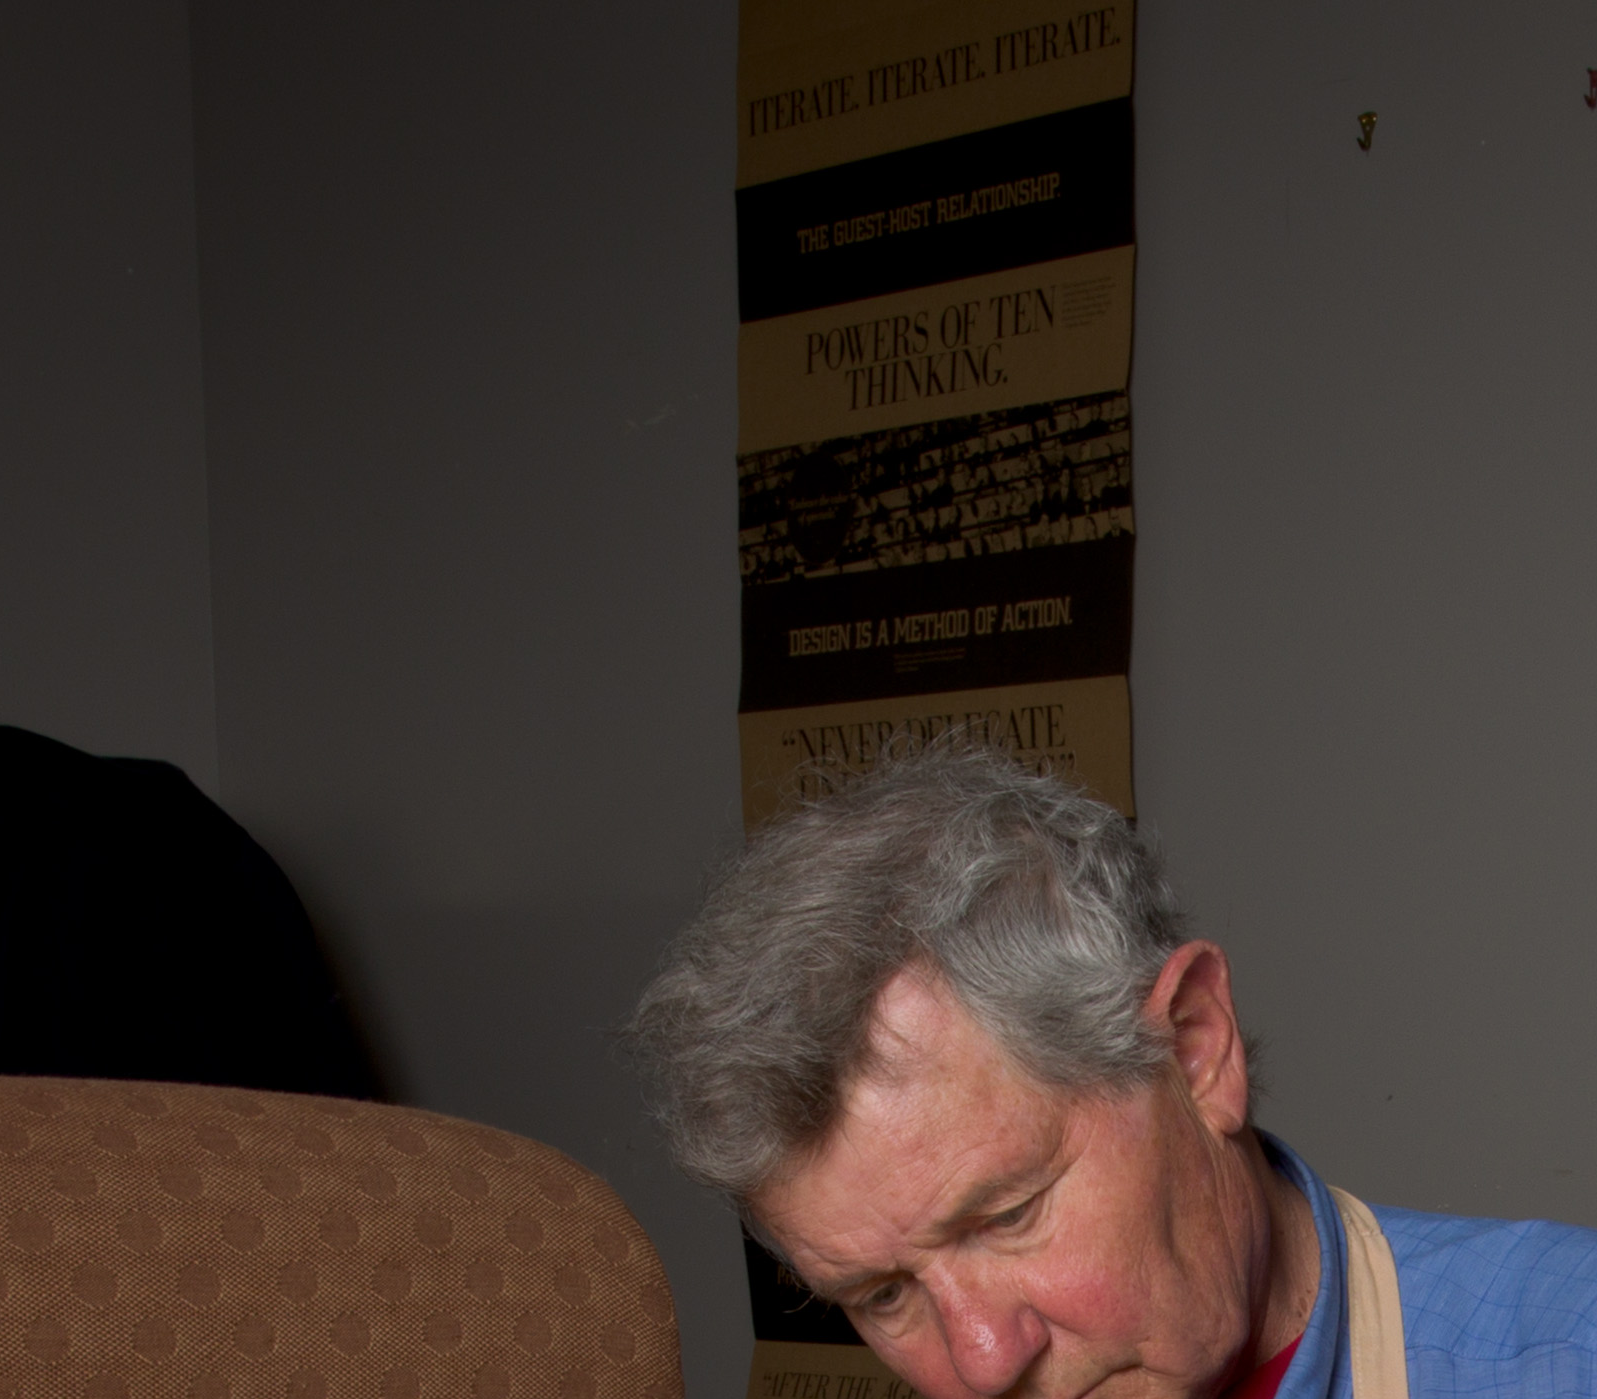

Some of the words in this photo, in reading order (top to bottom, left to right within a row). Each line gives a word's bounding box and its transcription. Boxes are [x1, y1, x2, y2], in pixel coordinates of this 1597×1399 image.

[749, 75, 859, 138] ITERATE.
[867, 42, 986, 107] ITERATE.
[994, 7, 1121, 75] ITERATE.
[796, 224, 829, 254] THE
[833, 201, 932, 247] GUEST-HOST
[936, 172, 1061, 225] RELATIONSHIP.
[805, 310, 929, 376] POWERS
[940, 301, 981, 349] OF
[989, 284, 1059, 340] TEN
[845, 342, 1008, 412] THINKING.
[788, 624, 851, 657] DESIGN
[855, 619, 872, 649] IS
[876, 618, 890, 647] A
[893, 608, 969, 645] METHOD
[974, 604, 998, 637] OF
[1001, 596, 1073, 632] ACTION.
[906, 704, 1066, 756] DELEGATE
